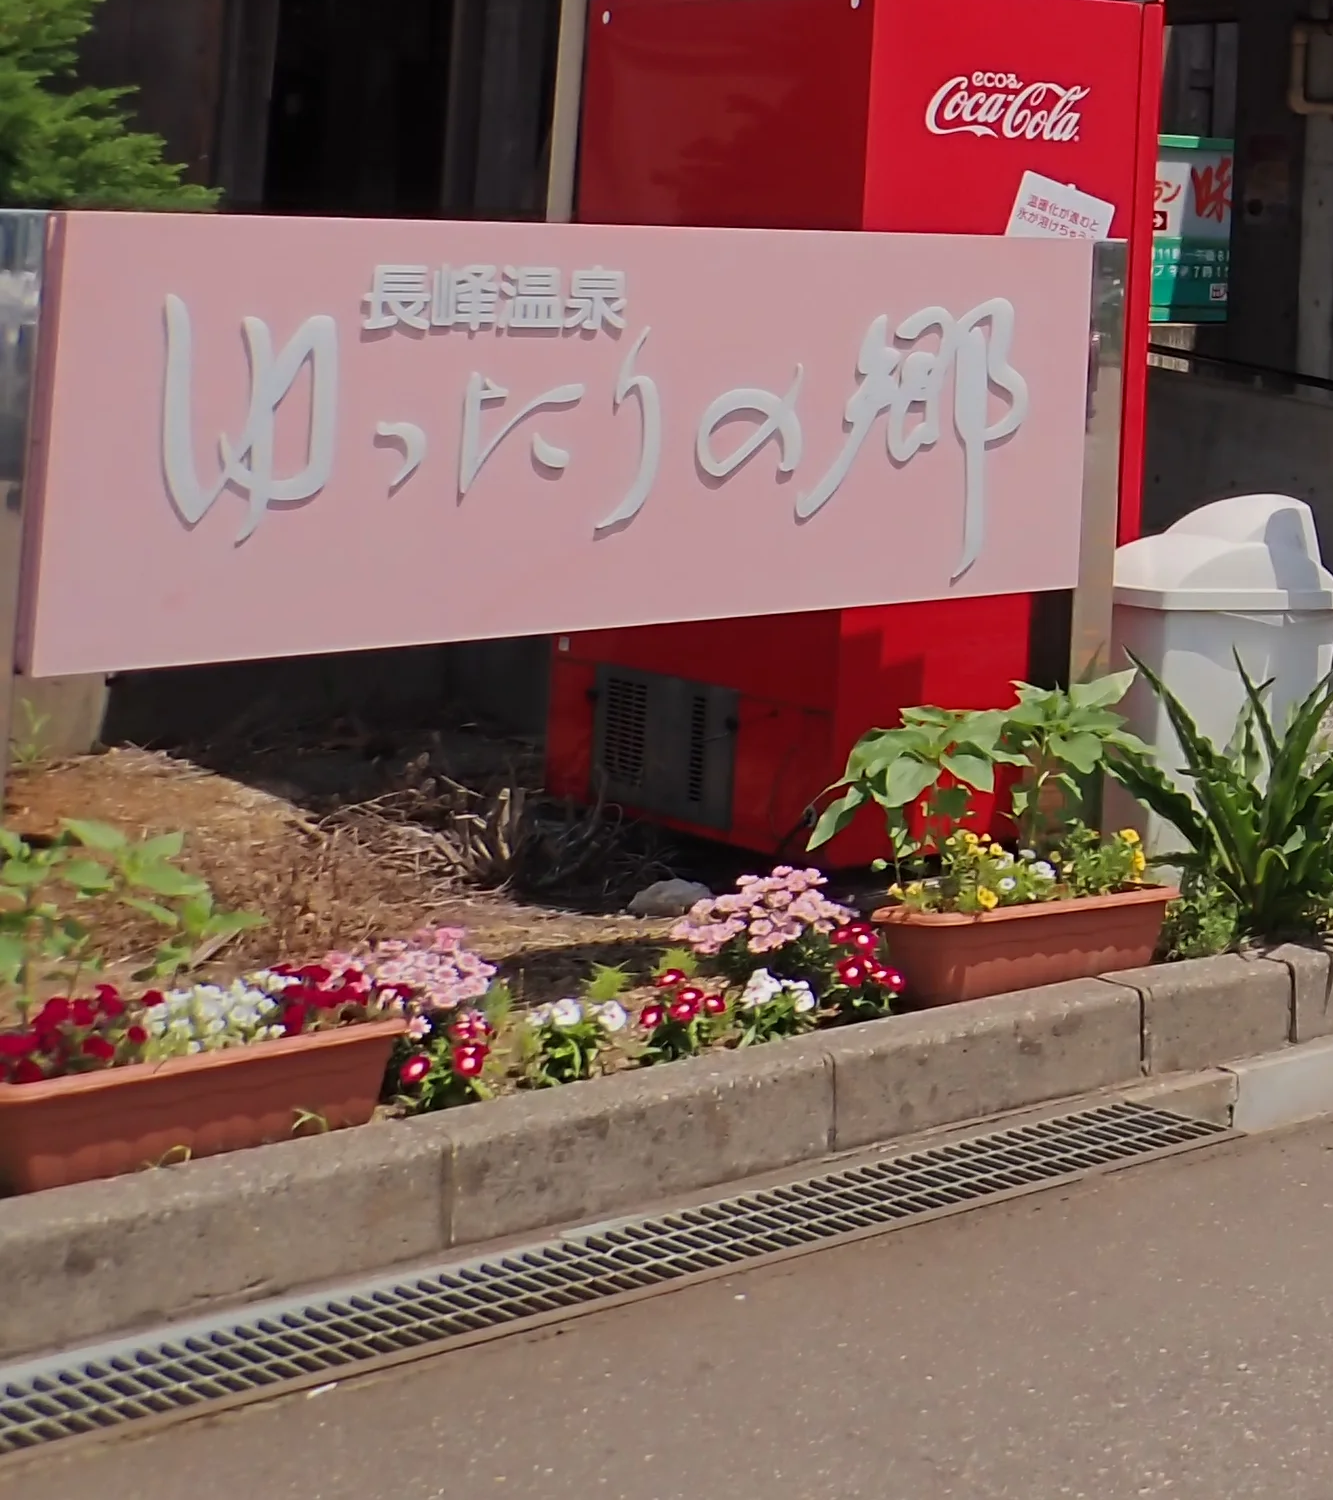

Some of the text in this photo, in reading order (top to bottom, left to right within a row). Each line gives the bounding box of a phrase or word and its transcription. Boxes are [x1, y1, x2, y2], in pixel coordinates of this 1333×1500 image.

[925, 76, 1091, 141] Coca-Cola
[360, 264, 627, 333] 長峰温泉
[162, 294, 1030, 580] ゆったりの郷
